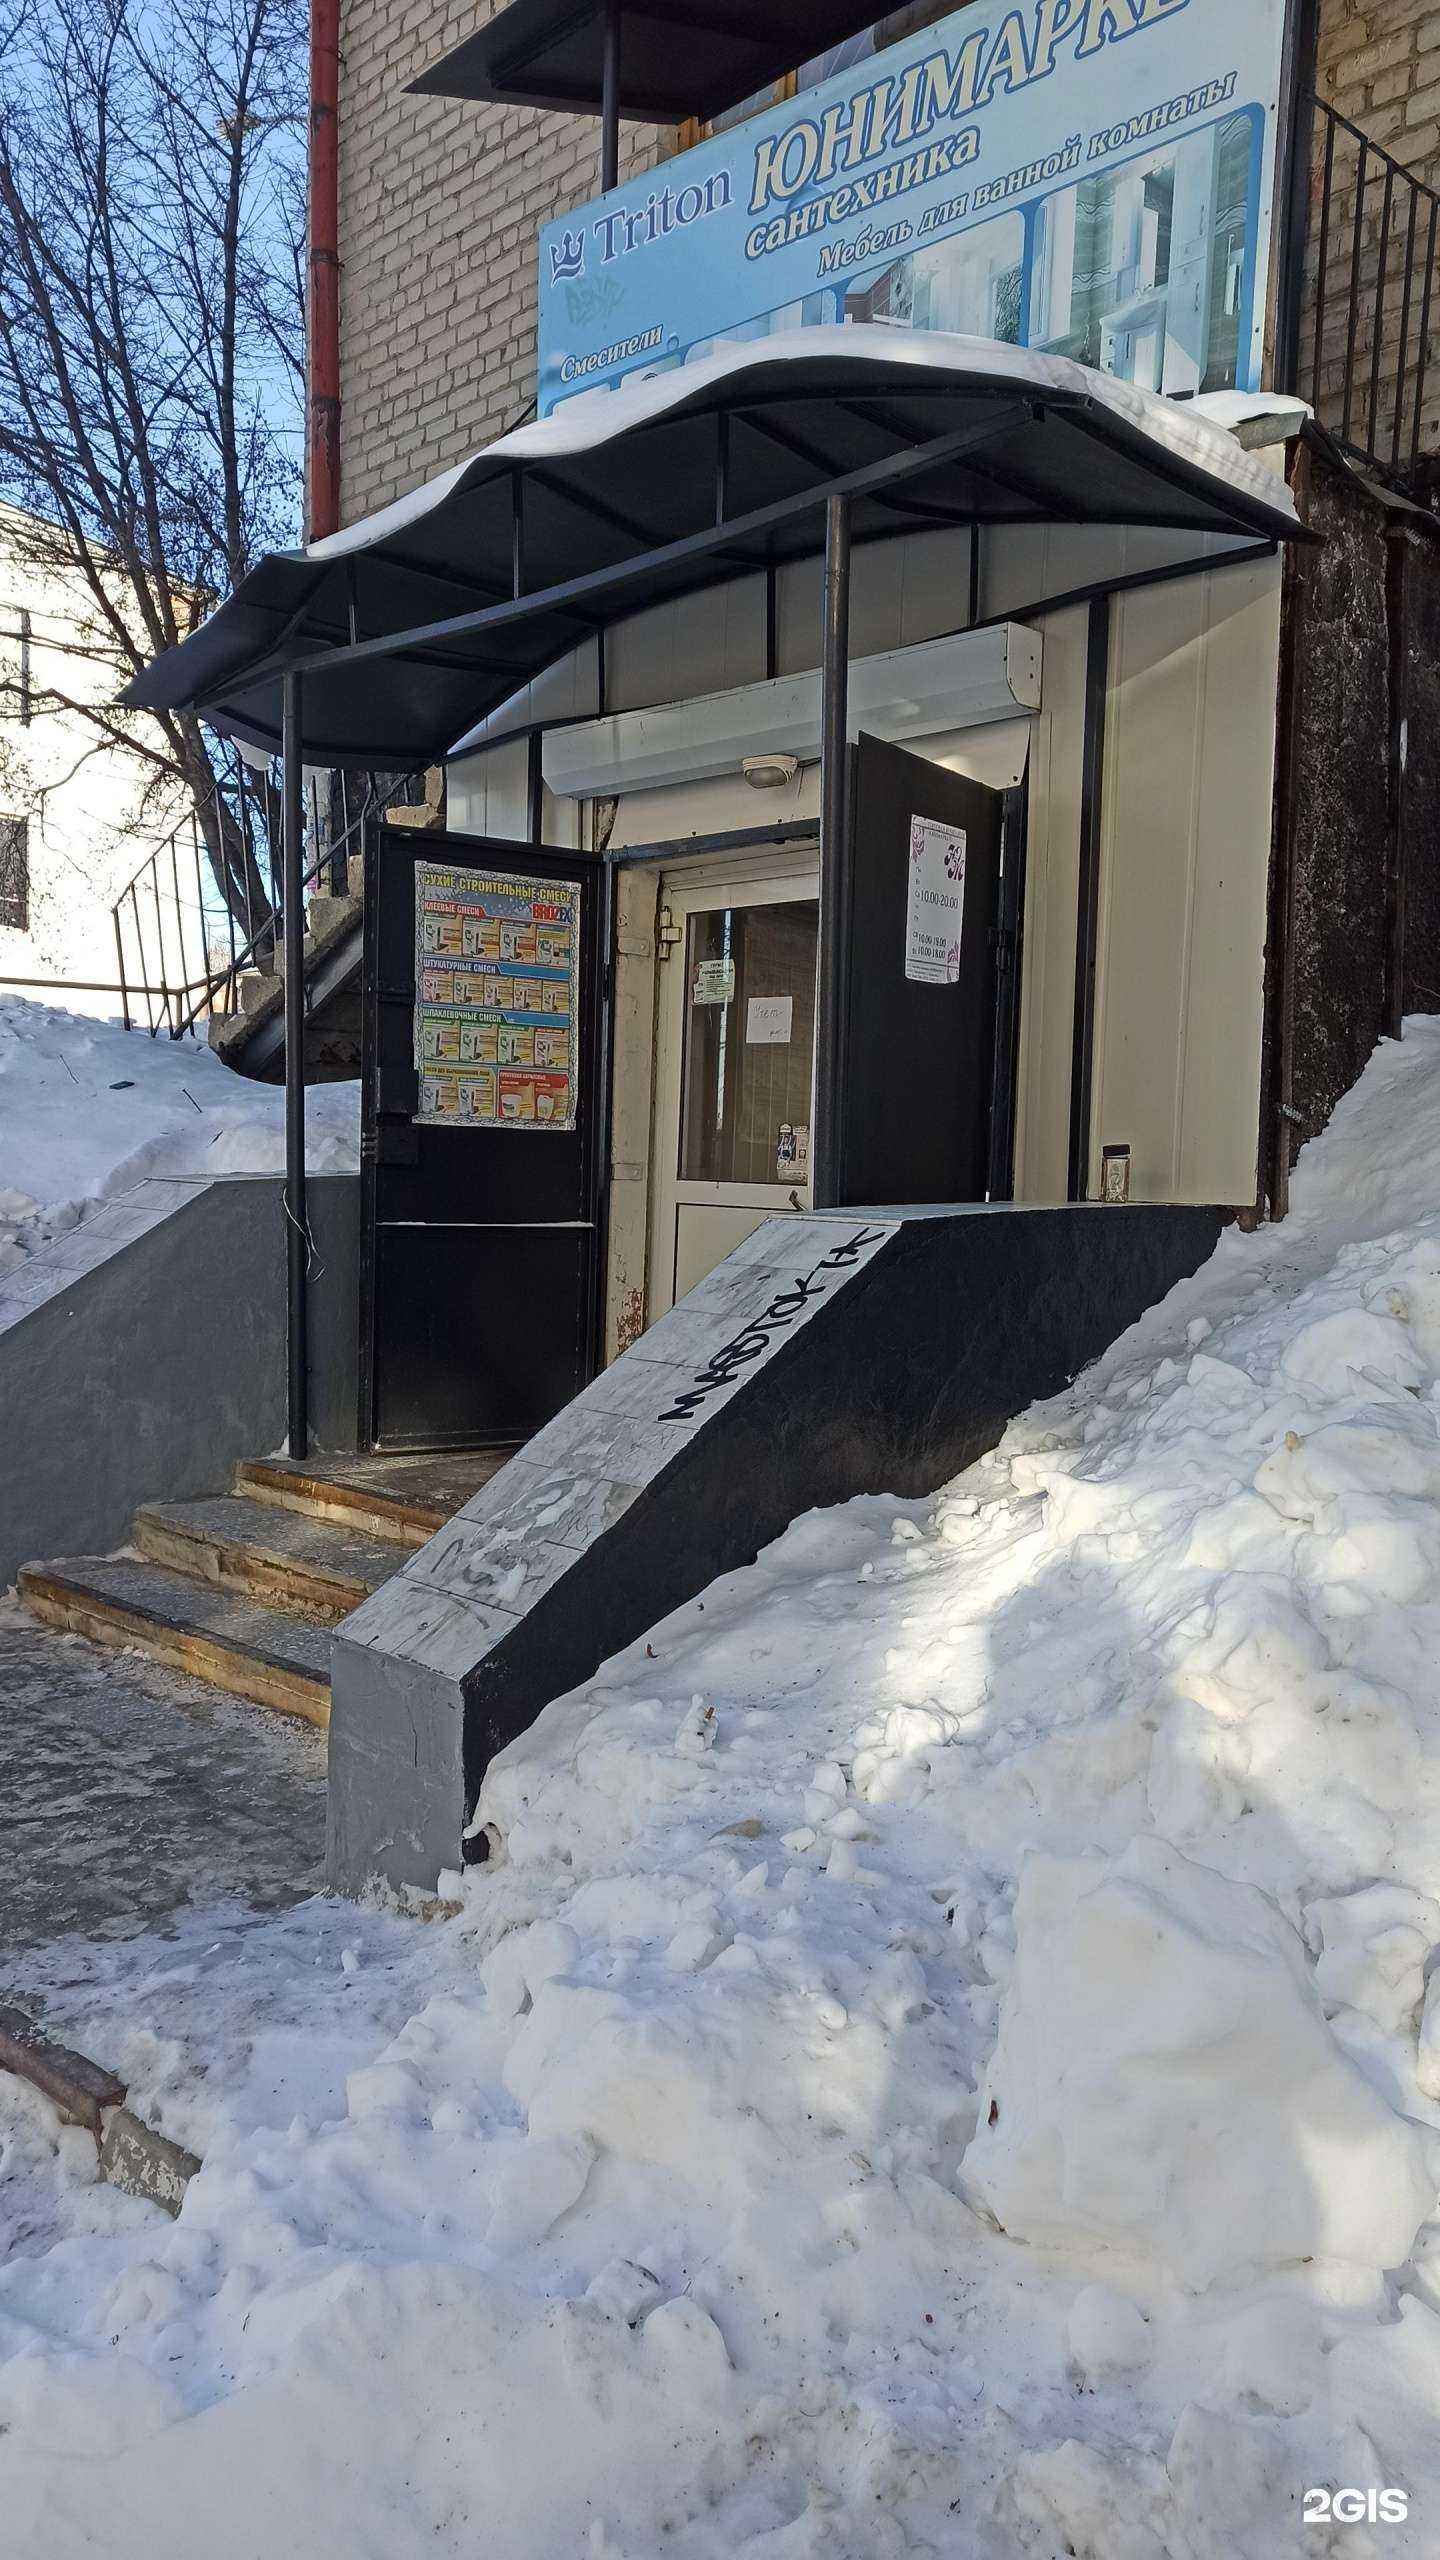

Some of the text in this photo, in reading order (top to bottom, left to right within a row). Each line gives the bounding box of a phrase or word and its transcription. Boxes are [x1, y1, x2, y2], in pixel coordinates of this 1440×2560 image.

[745, 125, 980, 261] сантехника
[817, 71, 1237, 277] Мебель для ванной комнаты
[594, 169, 735, 264] Triton
[560, 323, 664, 383] Смесители
[459, 879, 537, 899] СТРОИТЕЛЬНЫЕ
[423, 958, 472, 972] ШТУКАТУРНЫЕ
